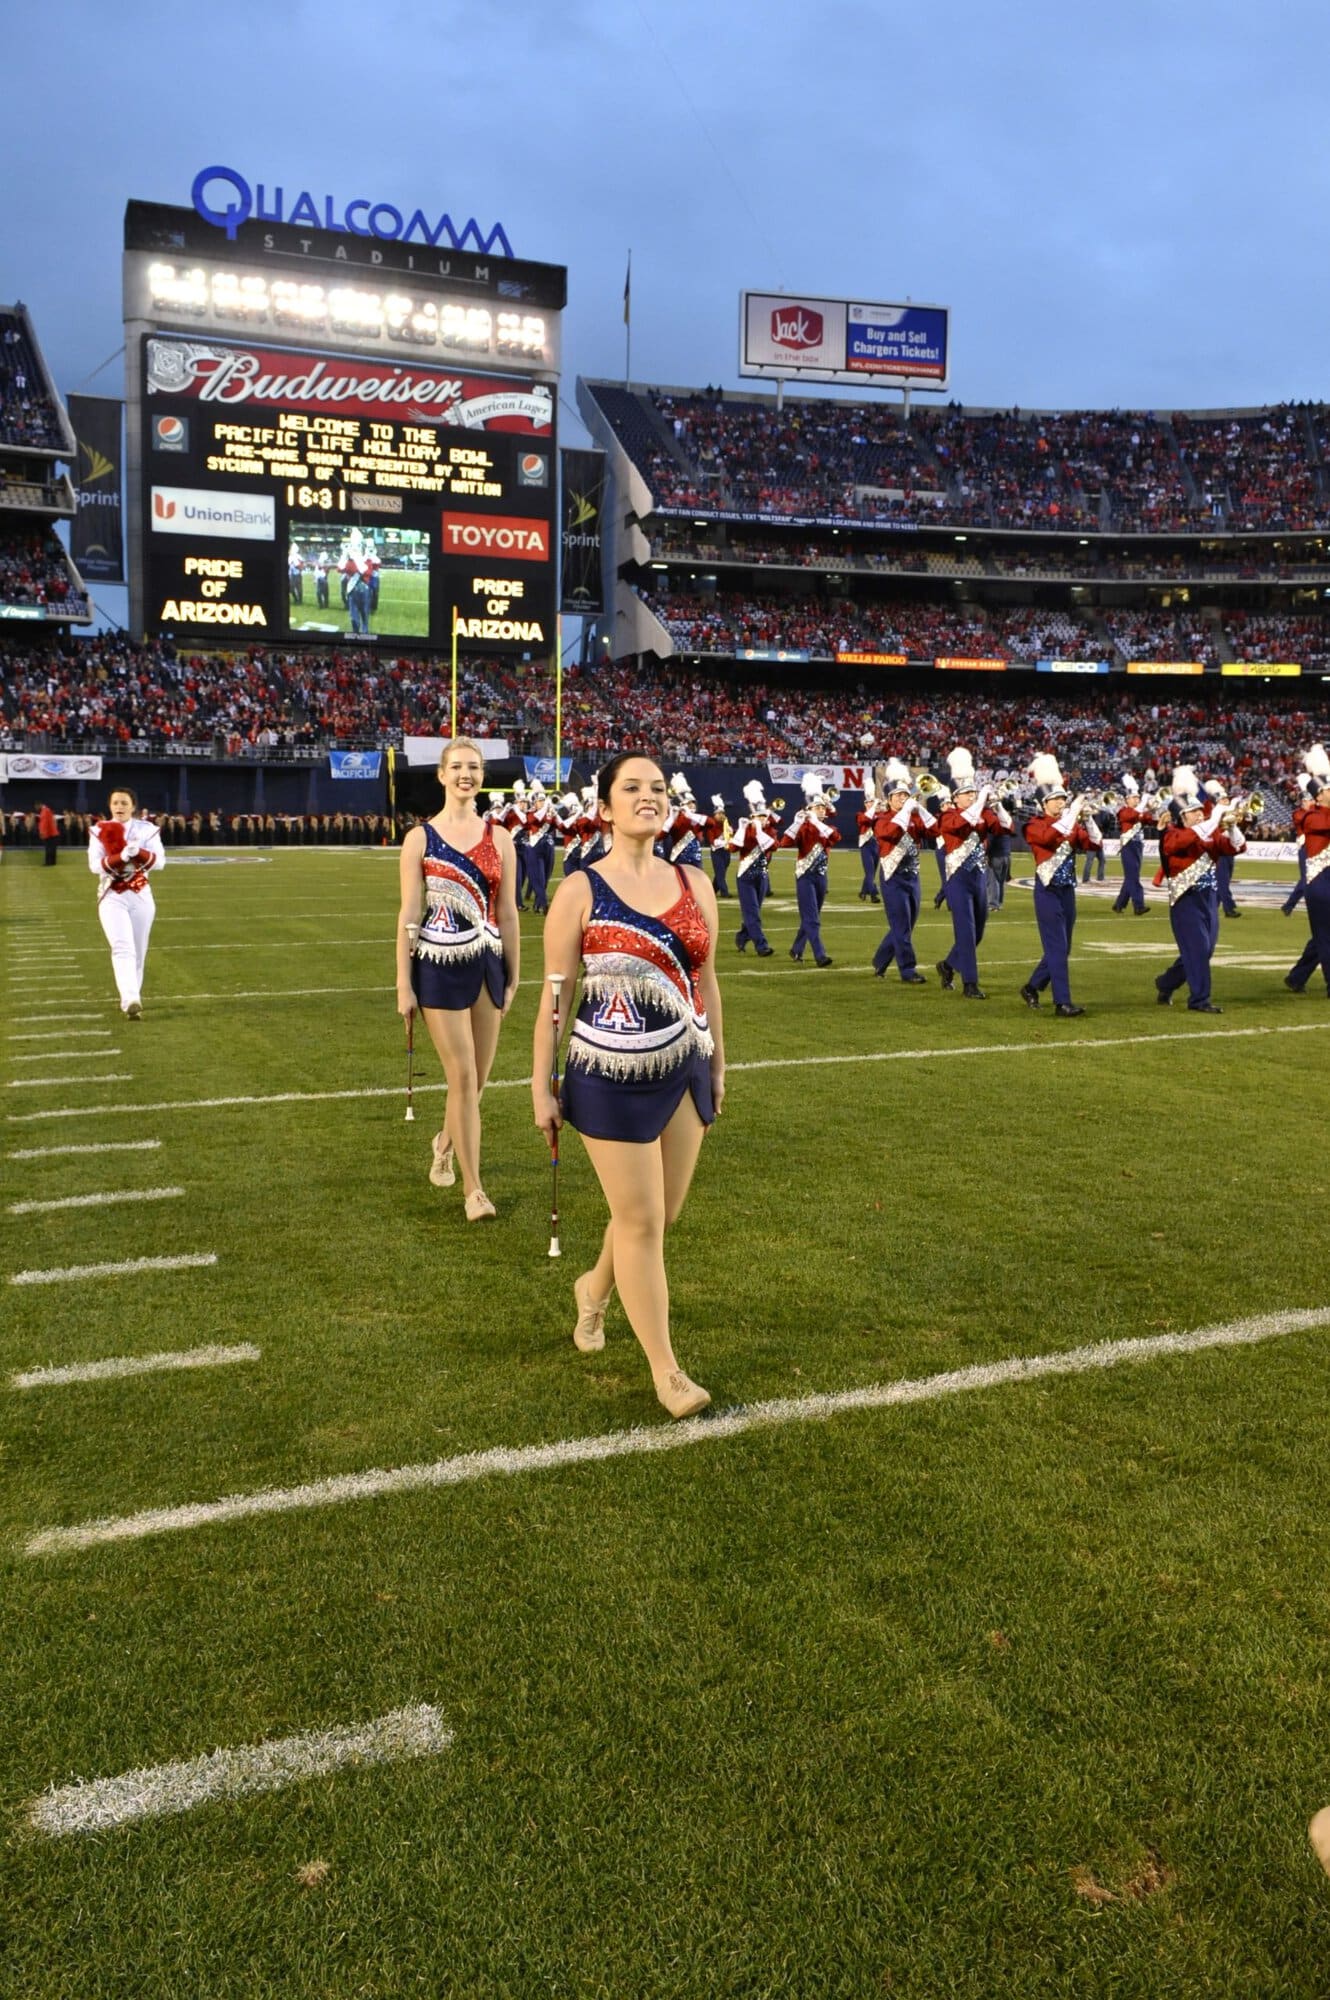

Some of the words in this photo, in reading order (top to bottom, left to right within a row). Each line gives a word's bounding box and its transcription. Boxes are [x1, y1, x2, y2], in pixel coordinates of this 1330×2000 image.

[192, 166, 514, 258] QUALCOMM
[264, 233, 490, 280] STADIUM
[771, 311, 822, 344] Jack
[866, 327, 886, 344] Buy
[887, 331, 907, 343] and
[908, 331, 927, 344] Sell
[853, 341, 899, 357] Chargers
[900, 345, 940, 360] Tickets!
[186, 353, 464, 404] Budweiser
[466, 401, 516, 421] American
[518, 400, 549, 415] Lager
[279, 413, 361, 437] WELCOME
[369, 423, 394, 440] TO
[402, 426, 437, 445] THE
[214, 423, 299, 447] PACIFIC
[307, 433, 355, 453] LIFE
[363, 438, 442, 461] HOLIDAY
[449, 447, 494, 467] BOWL
[225, 443, 299, 463] PRE-GAME
[306, 452, 343, 467] SHOW
[350, 456, 429, 476] PRESENTED
[434, 463, 453, 478] BY
[460, 466, 487, 481] THE
[270, 461, 309, 480] BAND
[315, 466, 335, 481] OF
[342, 469, 369, 485] THE
[451, 480, 502, 498] NATION
[287, 485, 347, 511] 16:31
[743, 513, 756, 521] TEXT
[832, 518, 862, 527] LOCATION
[448, 525, 544, 551] TOYOTA
[562, 531, 601, 549] Sprint
[184, 557, 244, 578] PRIDE
[200, 580, 228, 598] OF
[473, 578, 524, 598] PRIDE
[161, 600, 267, 627] ARIZONA
[486, 599, 511, 616] OF
[455, 617, 545, 643] ARIZONA
[838, 653, 871, 663] WELLS
[874, 654, 906, 665] FARGO
[1051, 662, 1098, 673] GEICO
[1137, 664, 1193, 674] CYMER
[842, 768, 865, 788] N
[425, 902, 460, 933] A
[592, 990, 646, 1033] A
